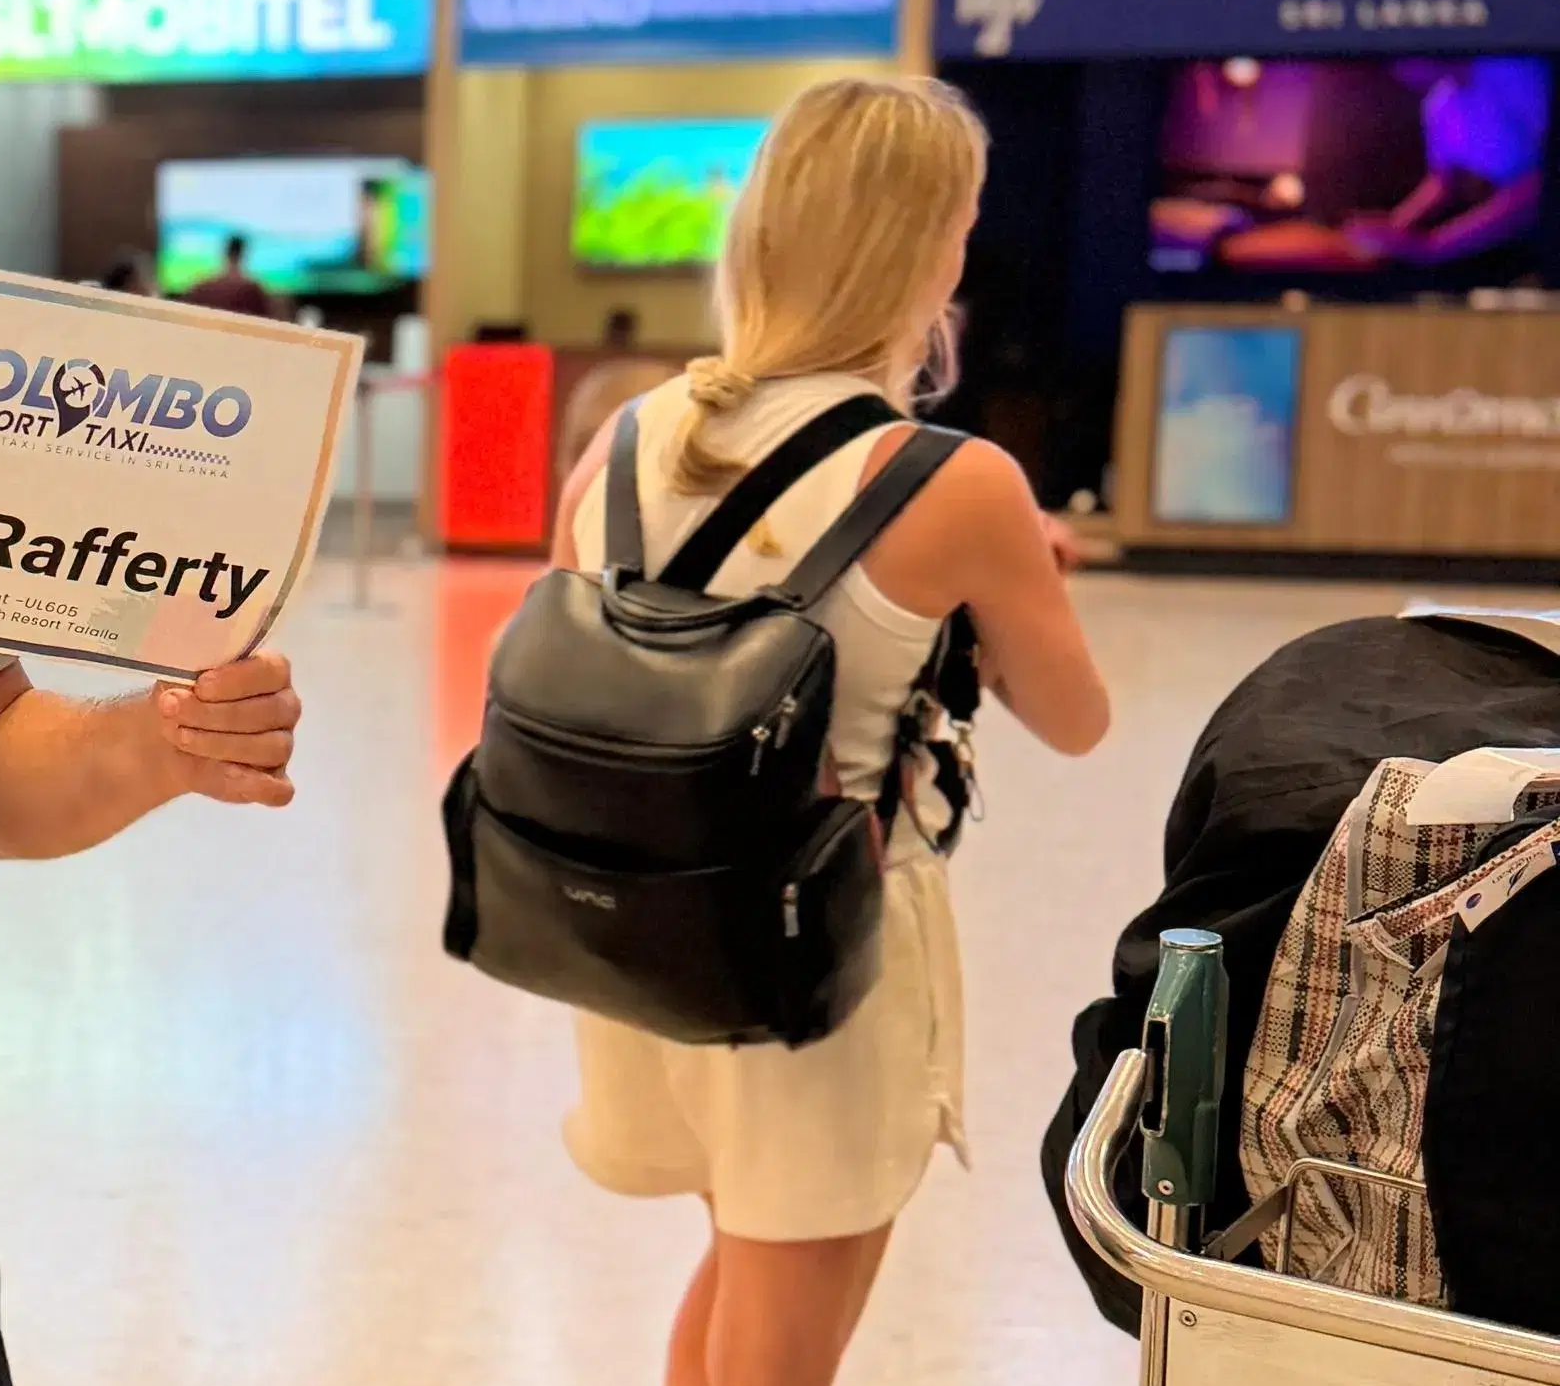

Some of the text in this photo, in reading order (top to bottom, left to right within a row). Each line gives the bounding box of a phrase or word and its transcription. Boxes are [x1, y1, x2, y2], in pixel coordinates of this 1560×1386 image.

[85, 423, 149, 453] TAXI
[1, 436, 36, 451] TAXI
[45, 443, 111, 462] SERVICE
[121, 455, 137, 465] IN
[146, 458, 169, 470] SRI
[179, 464, 229, 479] LANKA
[11, 612, 61, 630] Resort
